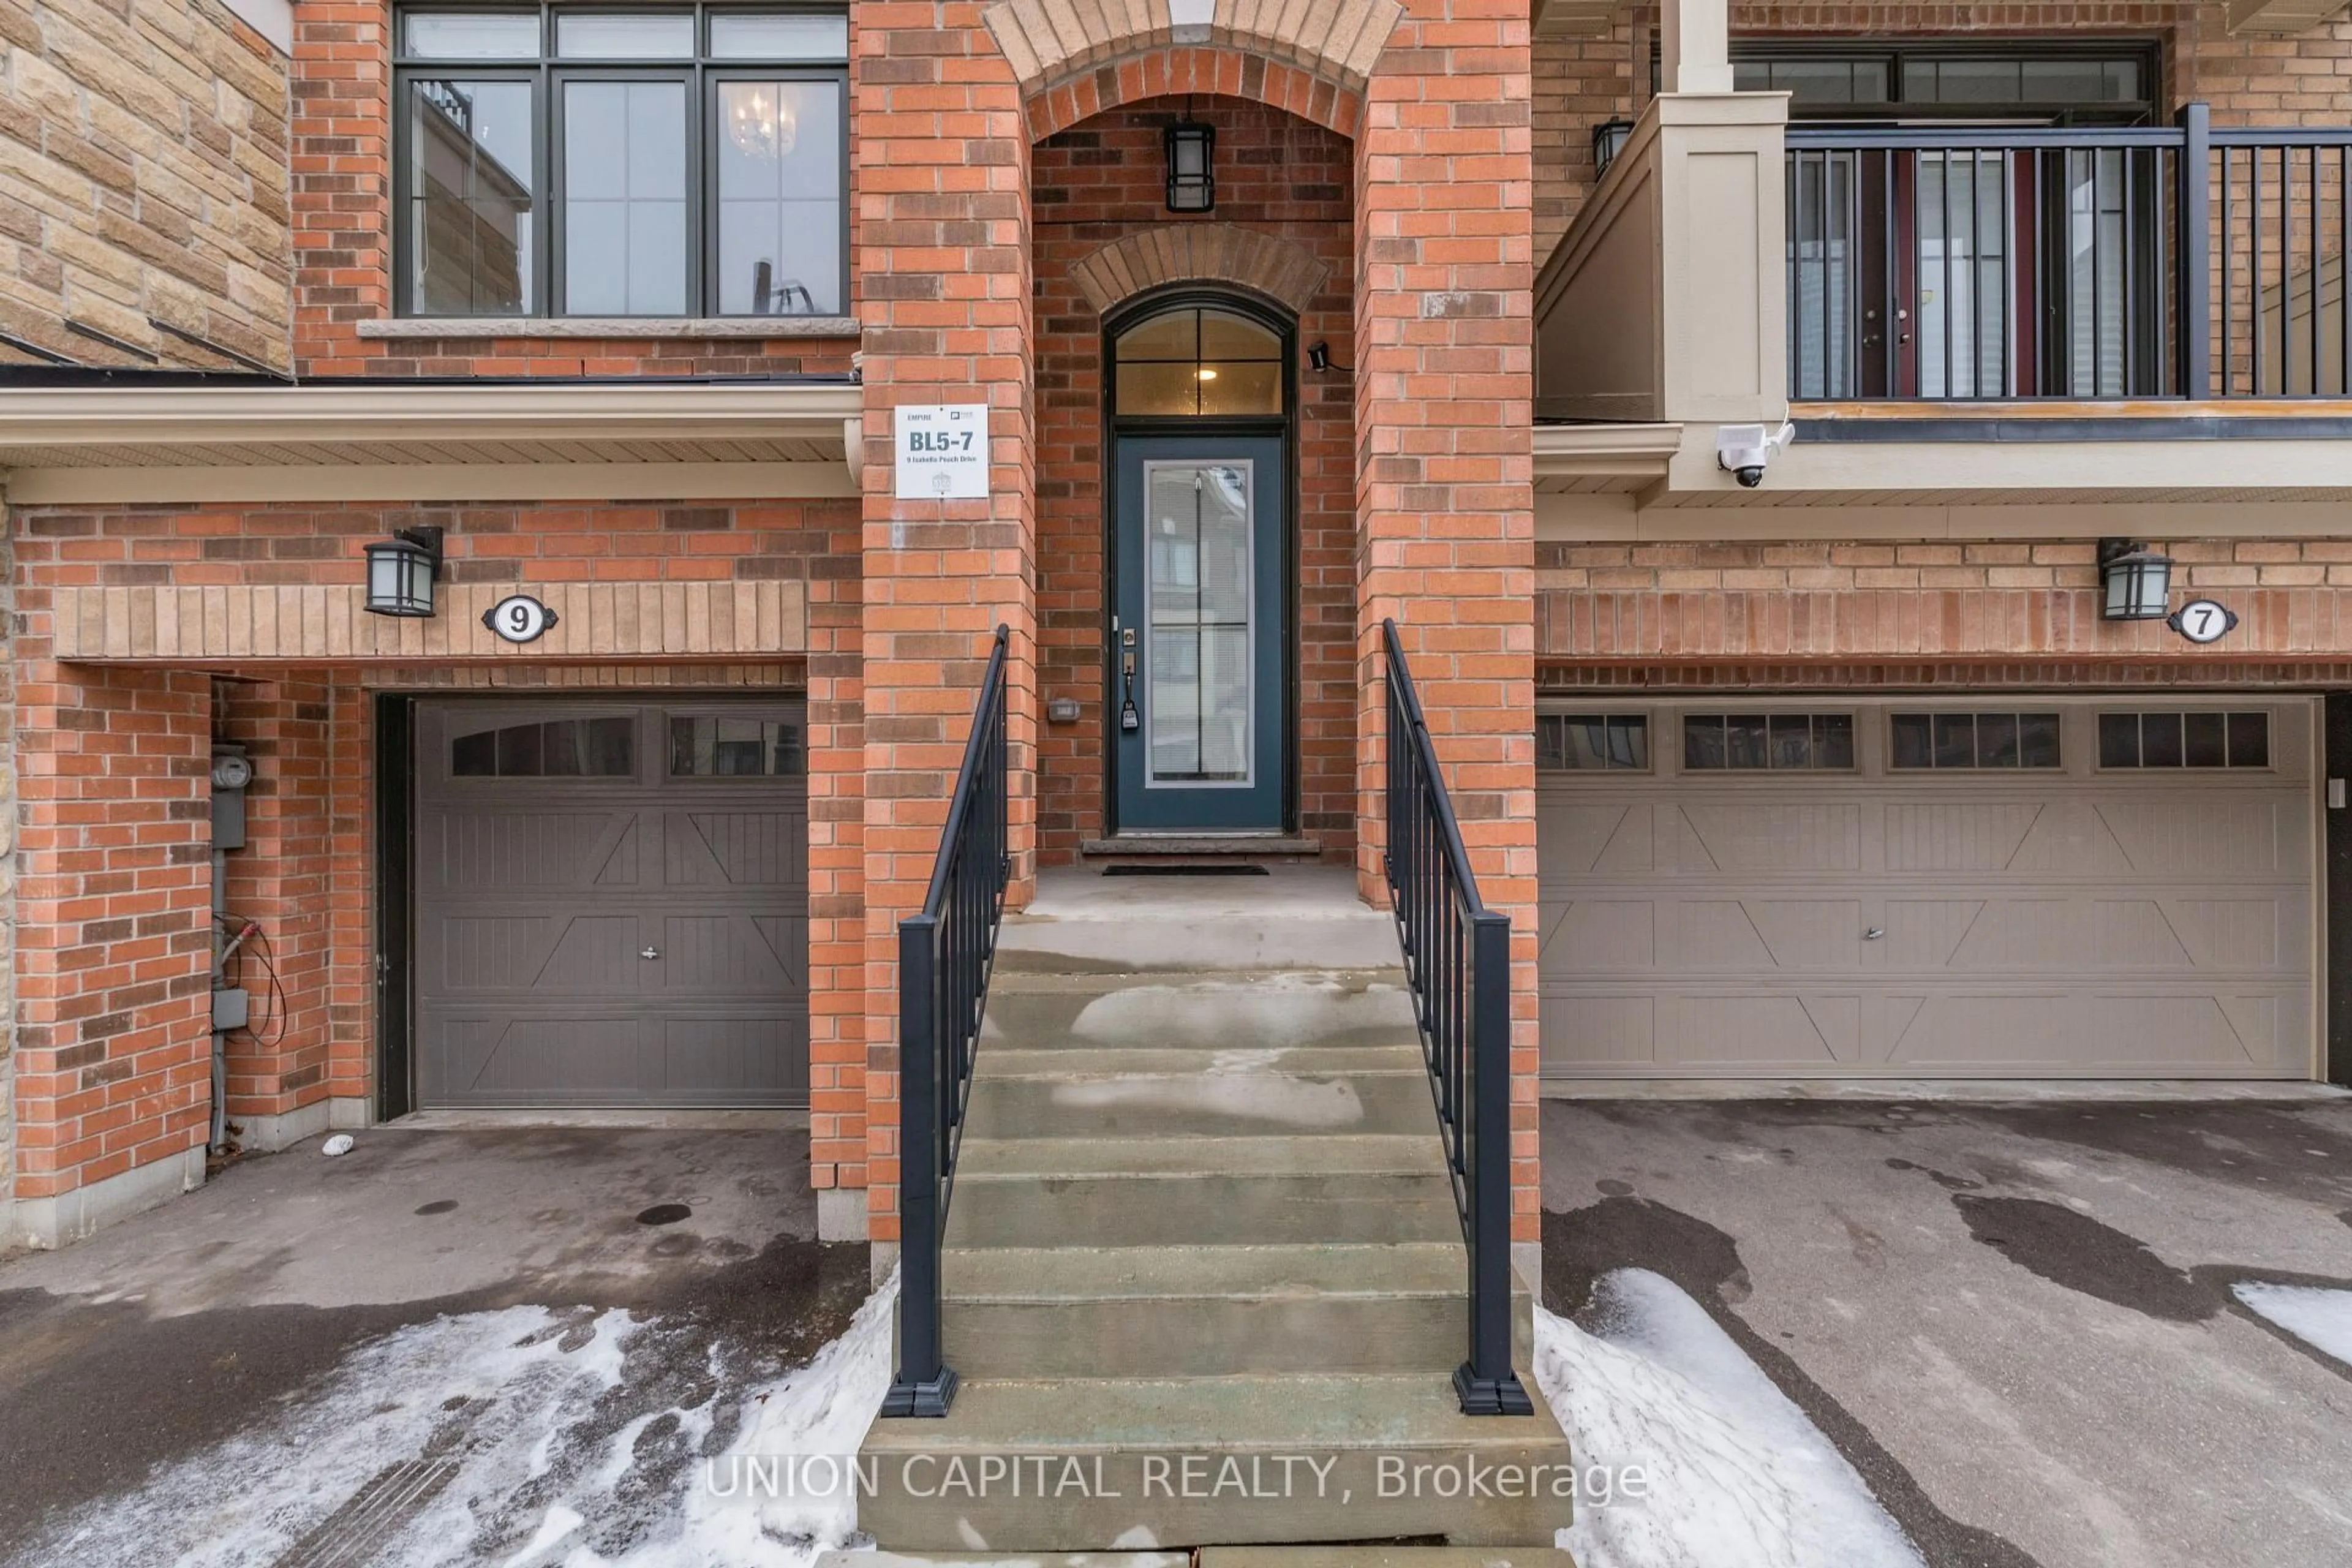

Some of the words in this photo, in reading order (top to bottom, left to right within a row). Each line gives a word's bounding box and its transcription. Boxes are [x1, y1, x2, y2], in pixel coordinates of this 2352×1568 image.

[910, 431, 973, 451] BL5-7
[510, 605, 529, 633] 9
[2195, 609, 2212, 635] 7
